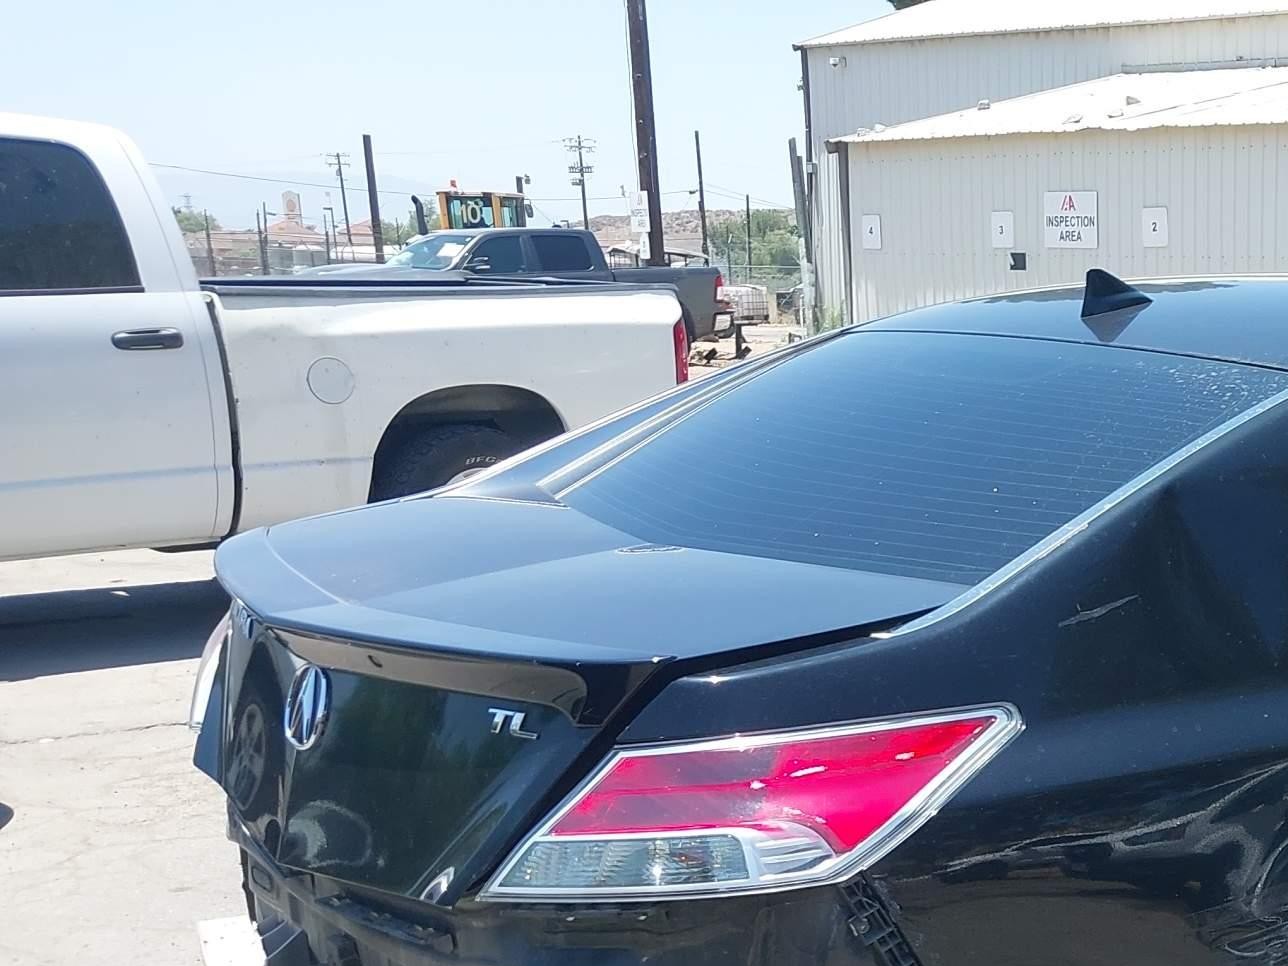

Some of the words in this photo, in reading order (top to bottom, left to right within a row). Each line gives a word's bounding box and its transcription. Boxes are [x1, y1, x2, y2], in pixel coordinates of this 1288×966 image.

[1045, 215, 1095, 228] INSPECTION
[1152, 222, 1158, 232] 2
[869, 226, 874, 235] 4
[999, 225, 1004, 235] 3
[1059, 230, 1082, 242] AREA
[488, 708, 539, 740] TL
